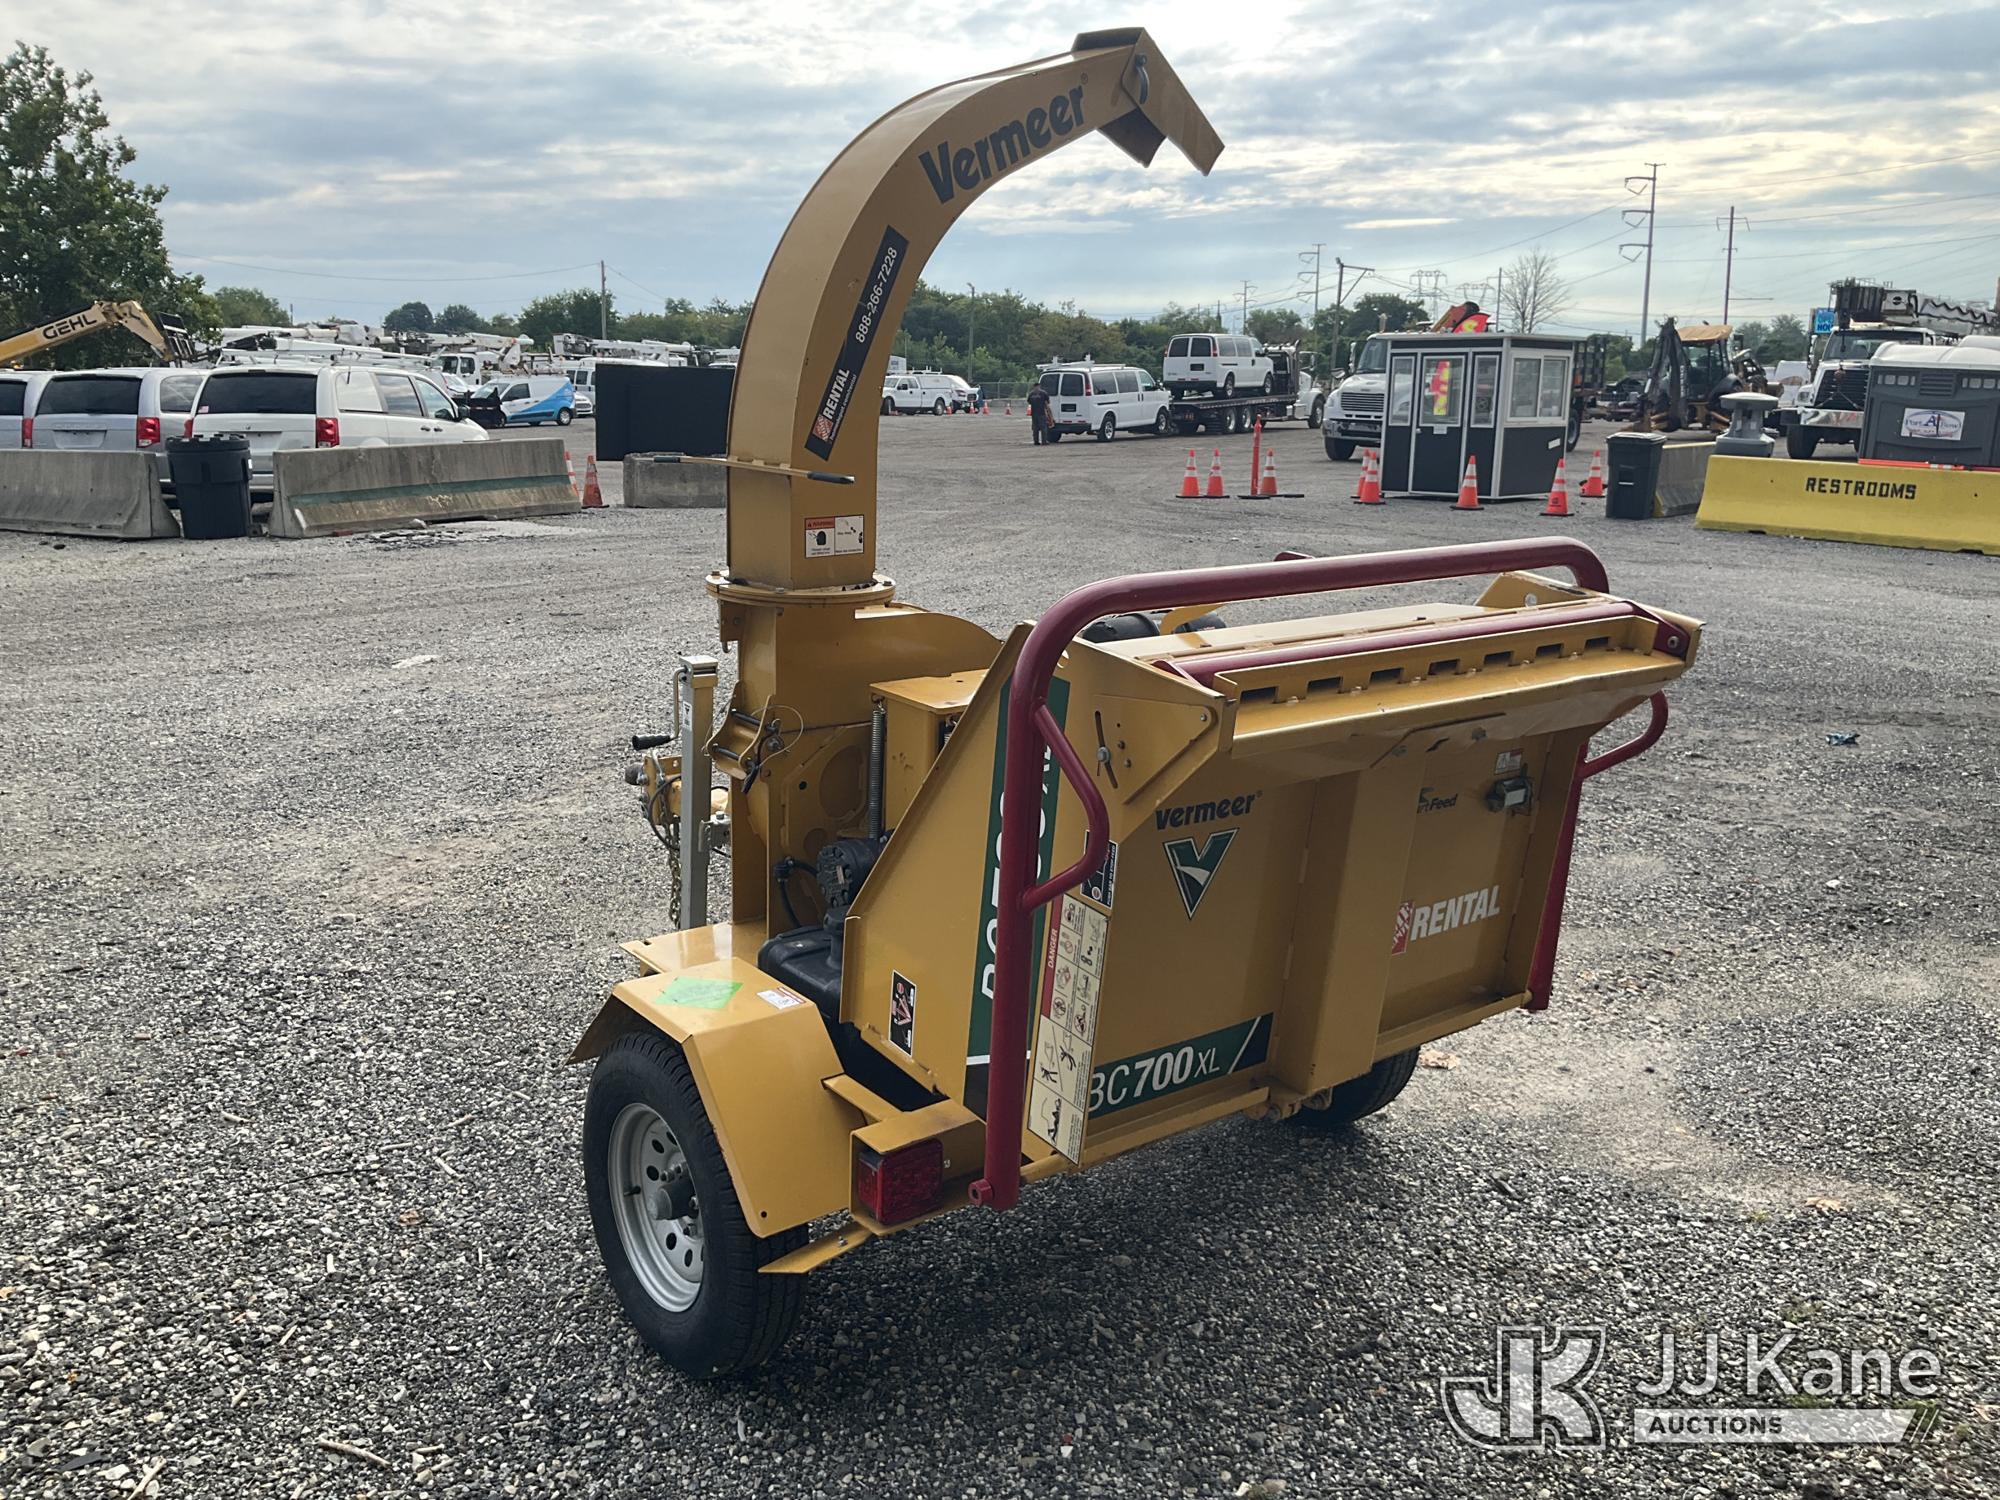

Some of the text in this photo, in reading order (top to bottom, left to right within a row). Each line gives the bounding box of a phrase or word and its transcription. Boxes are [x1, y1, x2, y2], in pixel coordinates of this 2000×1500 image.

[918, 84, 1084, 205] Vermeer
[855, 246, 898, 344] 888-266-7228
[42, 313, 98, 340] GEHL
[822, 367, 850, 420] RENTAL
[1805, 476, 1917, 500] RESTROOMS
[1155, 793, 1256, 831] Vermeer
[1410, 884, 1500, 942] RENTAL
[1047, 928, 1058, 969] DANGER
[1194, 1047, 1220, 1078] XL
